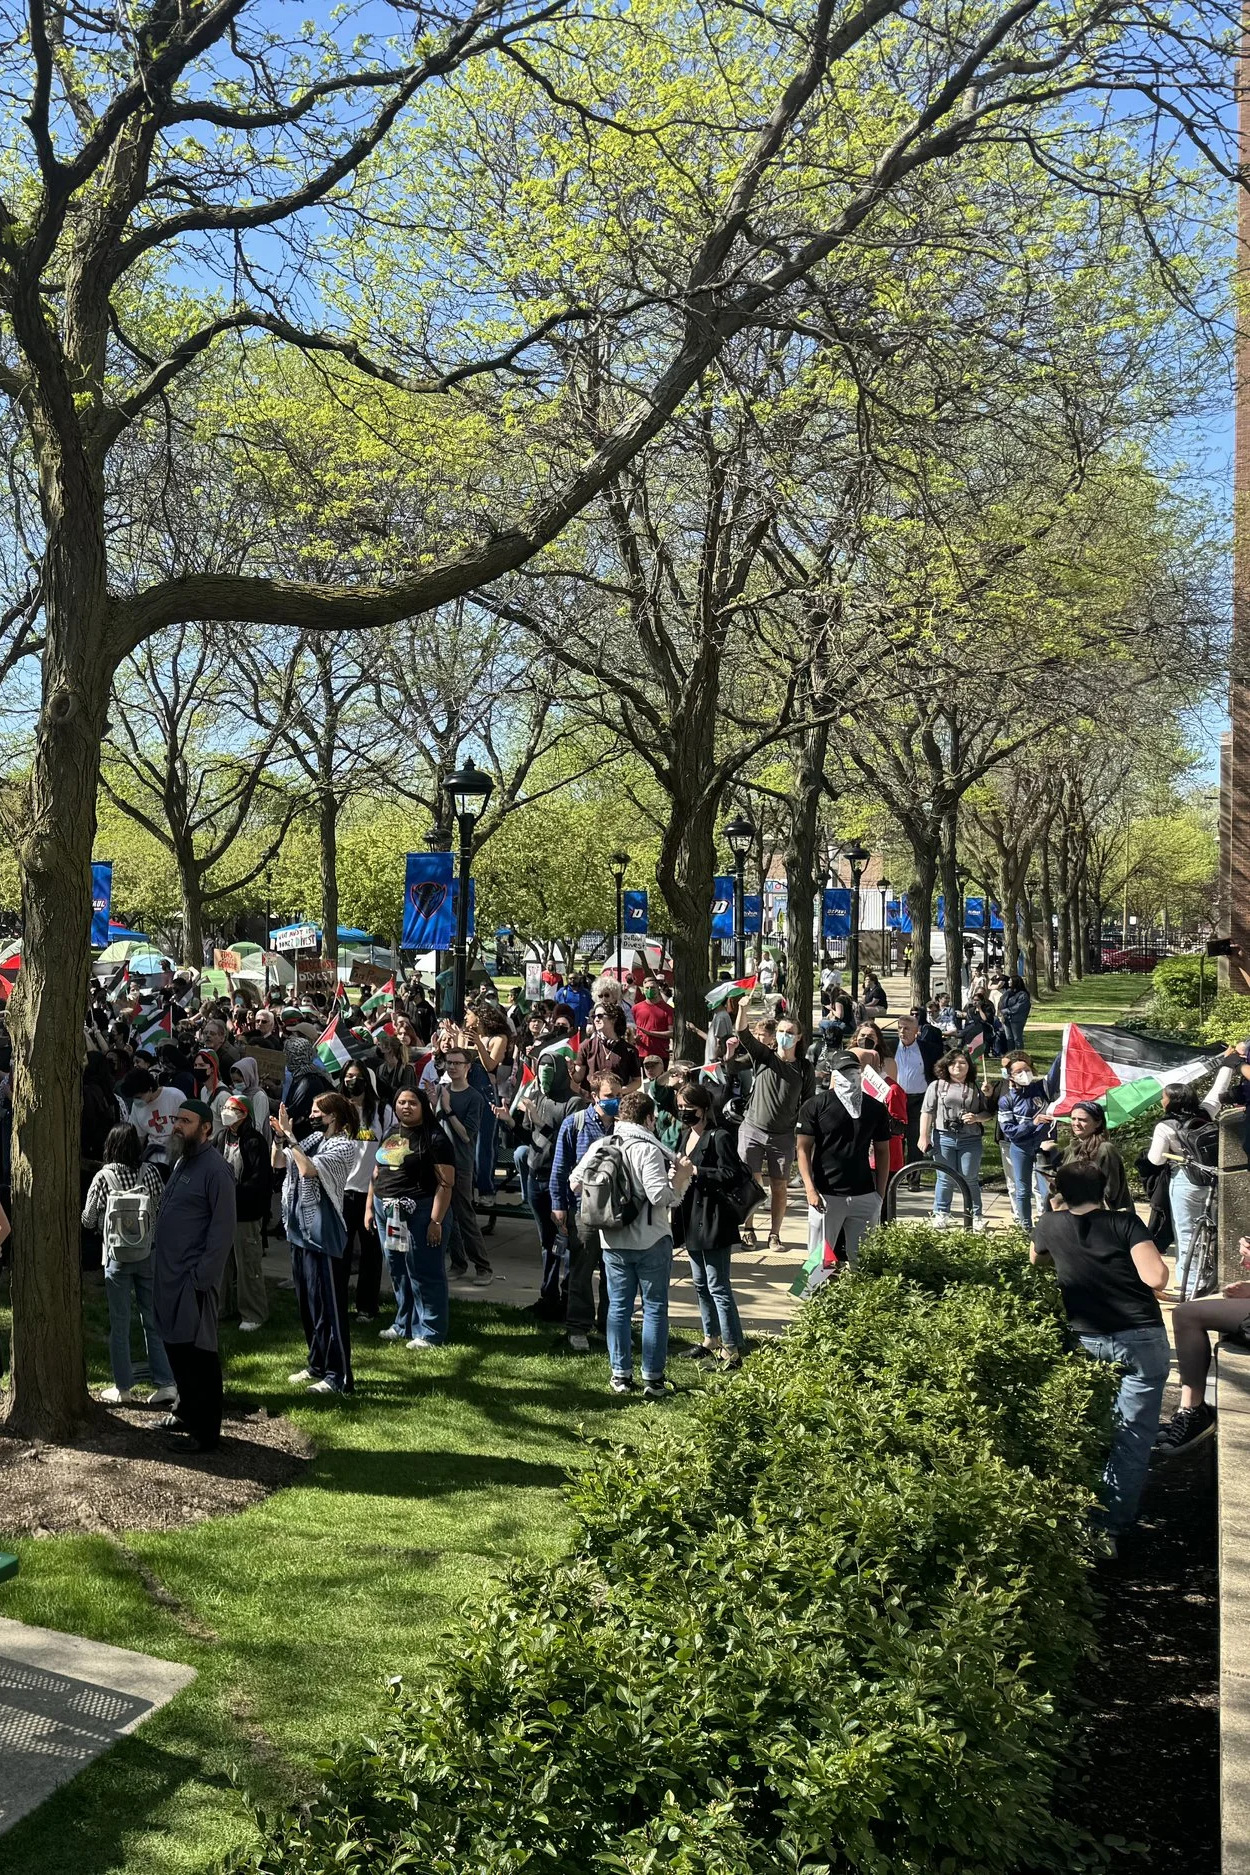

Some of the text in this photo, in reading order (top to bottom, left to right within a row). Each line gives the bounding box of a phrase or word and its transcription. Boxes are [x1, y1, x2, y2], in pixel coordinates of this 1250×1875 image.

[712, 901, 728, 914] D
[299, 970, 335, 981] DIVEST
[305, 979, 335, 990] NOW
